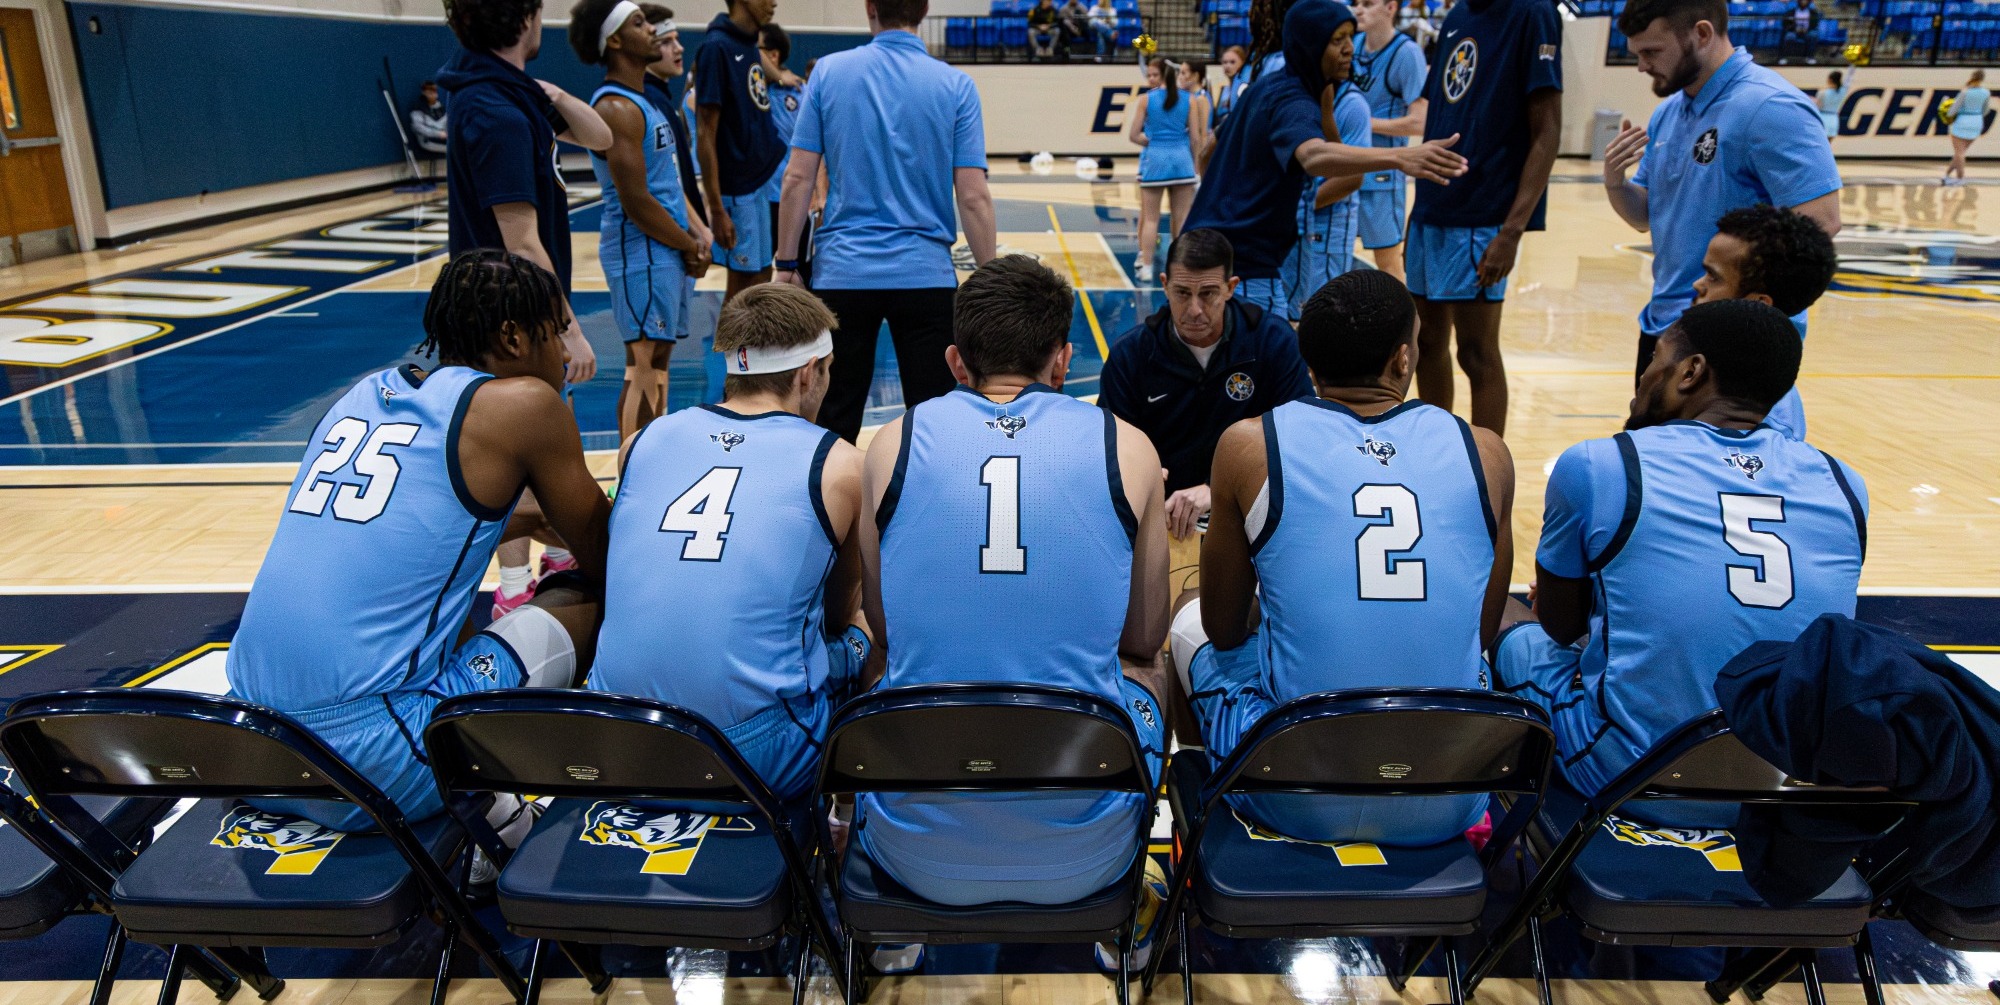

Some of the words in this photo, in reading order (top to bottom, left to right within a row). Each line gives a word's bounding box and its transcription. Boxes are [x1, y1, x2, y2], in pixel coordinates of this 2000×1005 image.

[0, 279, 310, 368] BU
[288, 416, 422, 524] 25
[658, 466, 743, 562] 4
[979, 455, 1027, 575] 1
[1352, 483, 1427, 601] 2
[1717, 491, 1795, 610] 5
